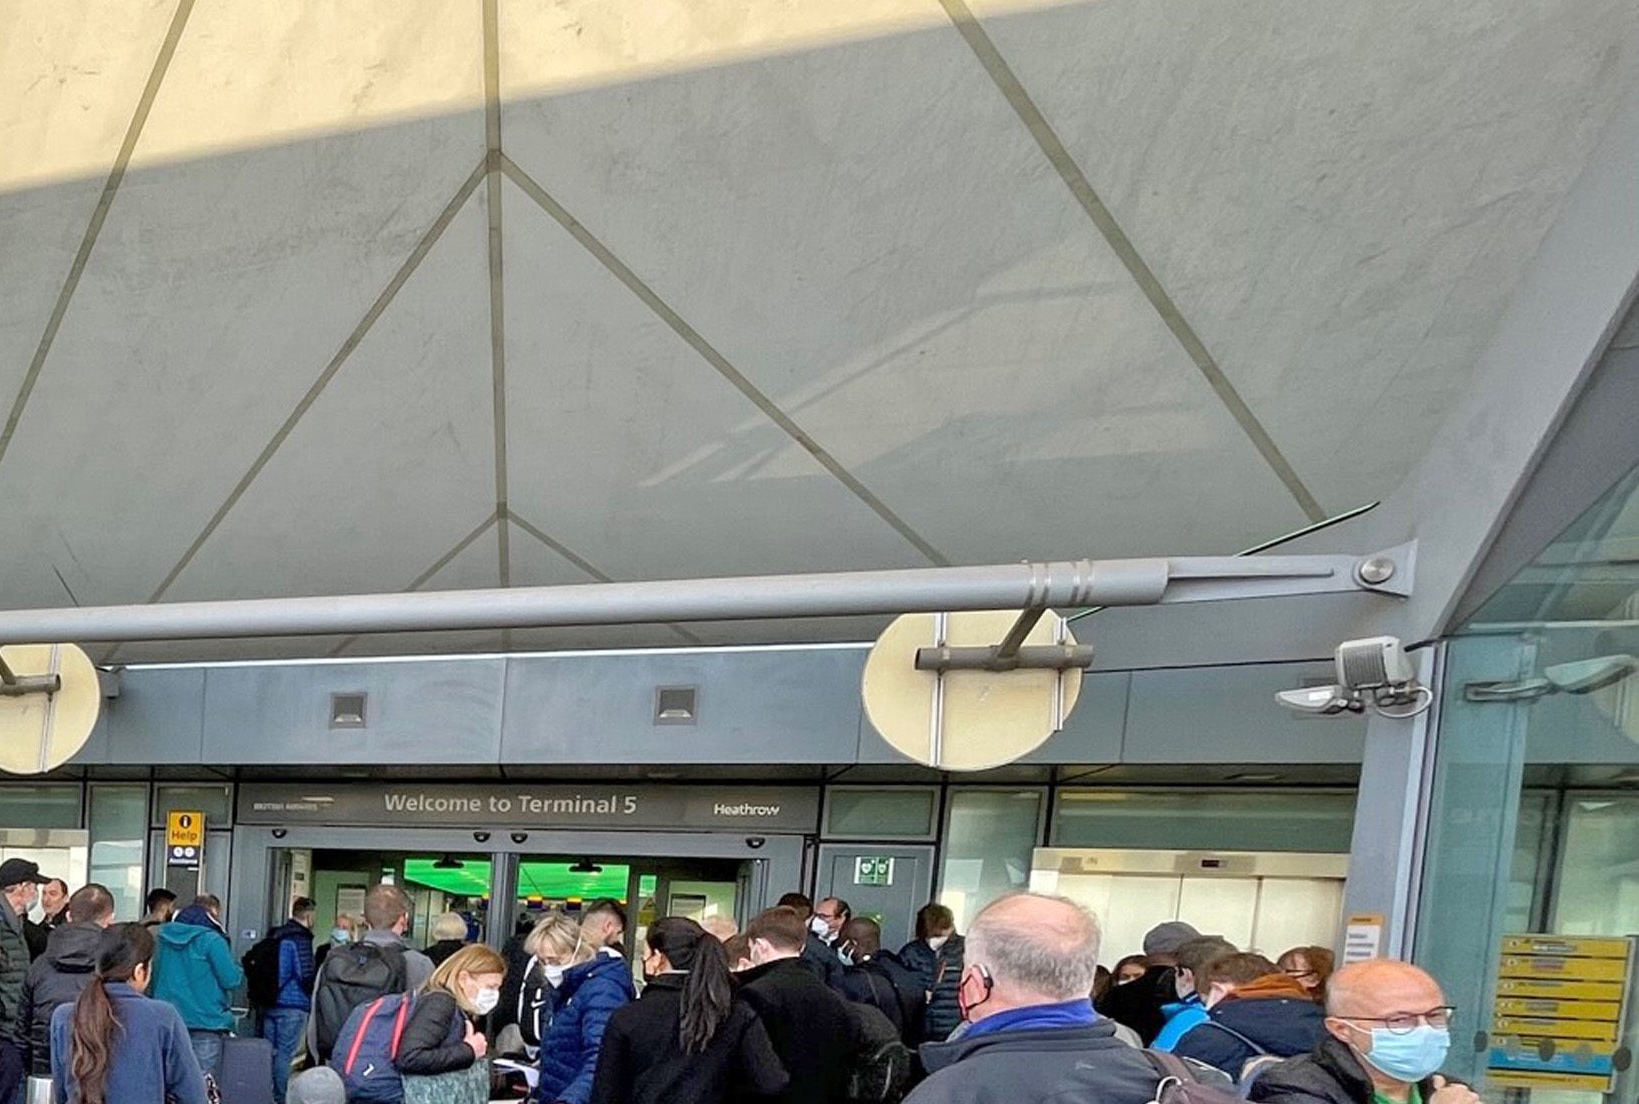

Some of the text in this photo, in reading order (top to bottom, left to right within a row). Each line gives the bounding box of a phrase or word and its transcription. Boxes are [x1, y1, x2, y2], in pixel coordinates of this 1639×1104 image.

[384, 793, 638, 815] Welcome to Terminal 5
[713, 802, 780, 817] Heathrow
[172, 830, 198, 842] Help
